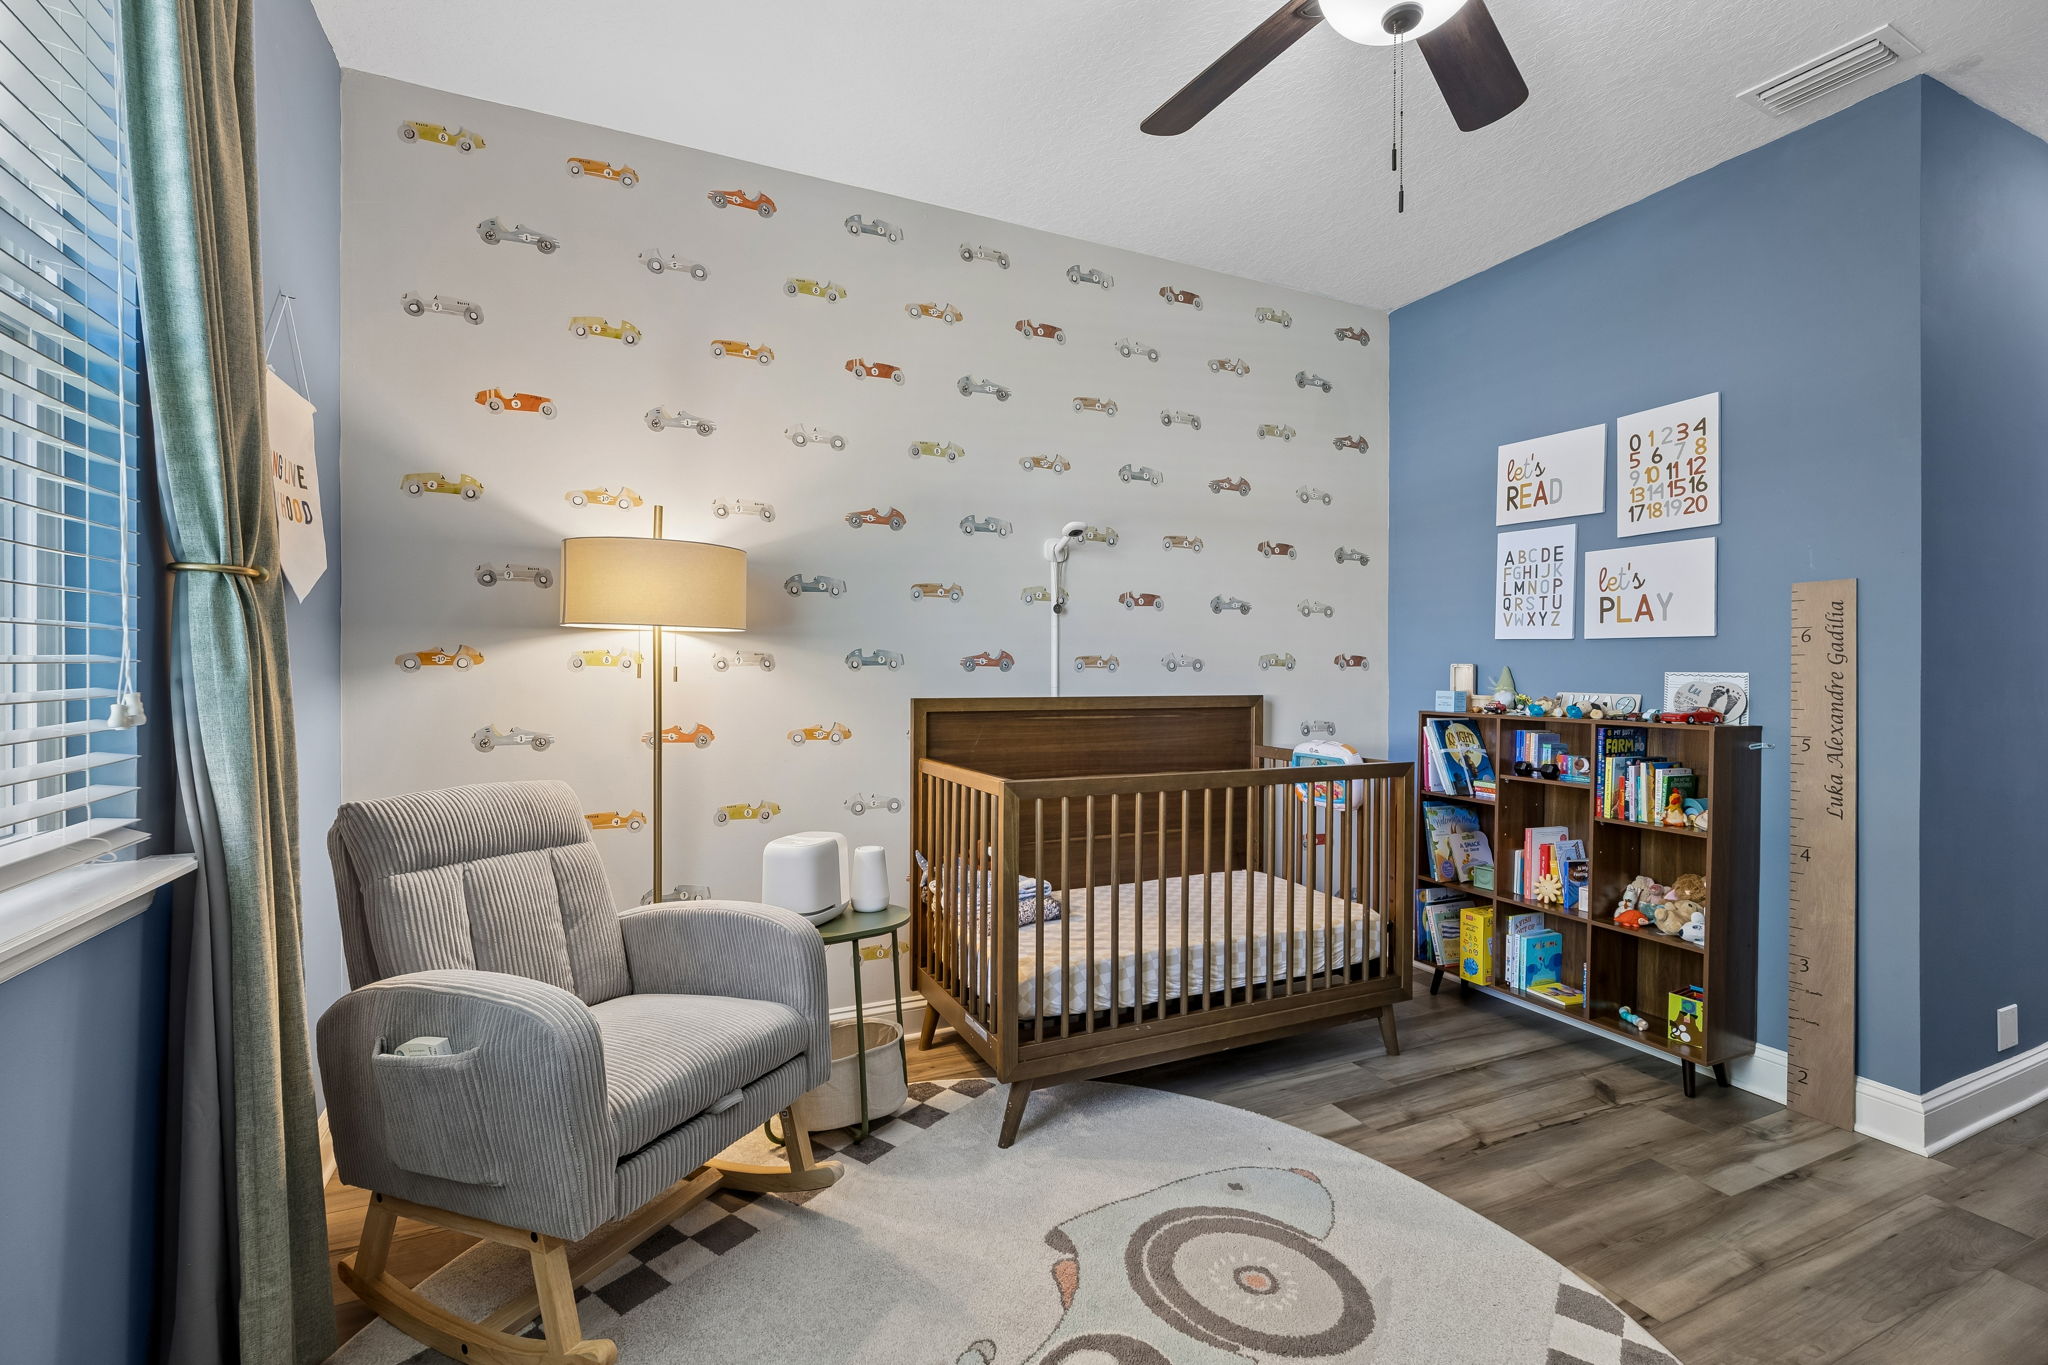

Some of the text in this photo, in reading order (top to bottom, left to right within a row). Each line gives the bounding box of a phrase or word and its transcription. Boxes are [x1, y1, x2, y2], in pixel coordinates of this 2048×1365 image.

[1630, 417, 1706, 452] 0 1 2 3 4
[1507, 452, 1546, 482] let's
[1629, 437, 1707, 469] 5 6 7 8
[284, 457, 308, 490] LIVE
[1630, 456, 1707, 487] 9 10 11 12
[1506, 477, 1563, 511] READ
[1630, 475, 1708, 503] 13 14 15 16
[1628, 495, 1708, 522] 17 18 19 20
[1598, 562, 1646, 592] let's
[1599, 591, 1674, 624] PLAY
[1801, 628, 1812, 643] 6
[1824, 671, 1844, 769] Alexandre
[1605, 738, 1634, 753] FARM
[1801, 737, 1812, 752] 5
[1824, 773, 1844, 821] Luka
[1800, 848, 1811, 862] 4
[1800, 958, 1809, 973] 3
[1797, 1070, 1809, 1085] 2
